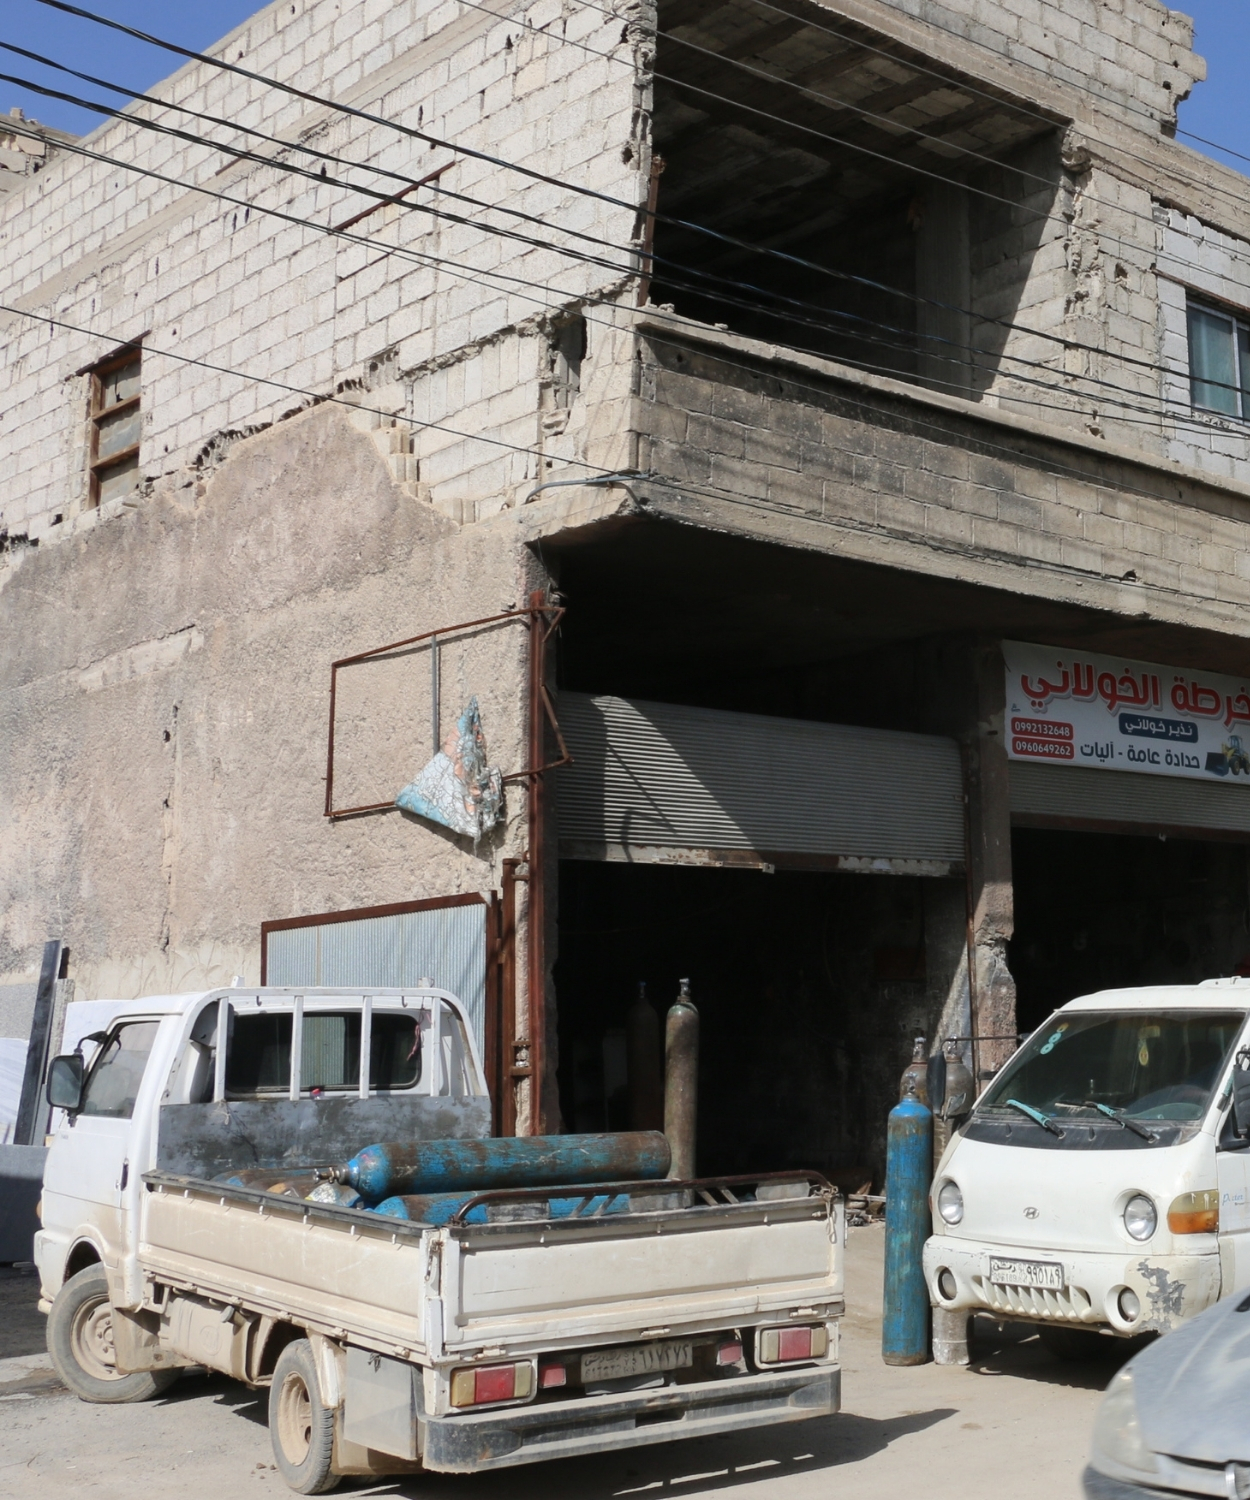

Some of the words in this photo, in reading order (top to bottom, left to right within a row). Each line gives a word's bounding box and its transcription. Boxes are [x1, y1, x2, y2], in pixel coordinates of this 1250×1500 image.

[1020, 659, 1160, 711] الخولاني
[1014, 721, 1070, 737] 0992132648
[1124, 716, 1166, 735] خولاني
[1168, 720, 1193, 737] نذير
[1015, 740, 1071, 756] 0960649262
[1127, 744, 1161, 766] عامة
[1165, 748, 1201, 769] حدادة
